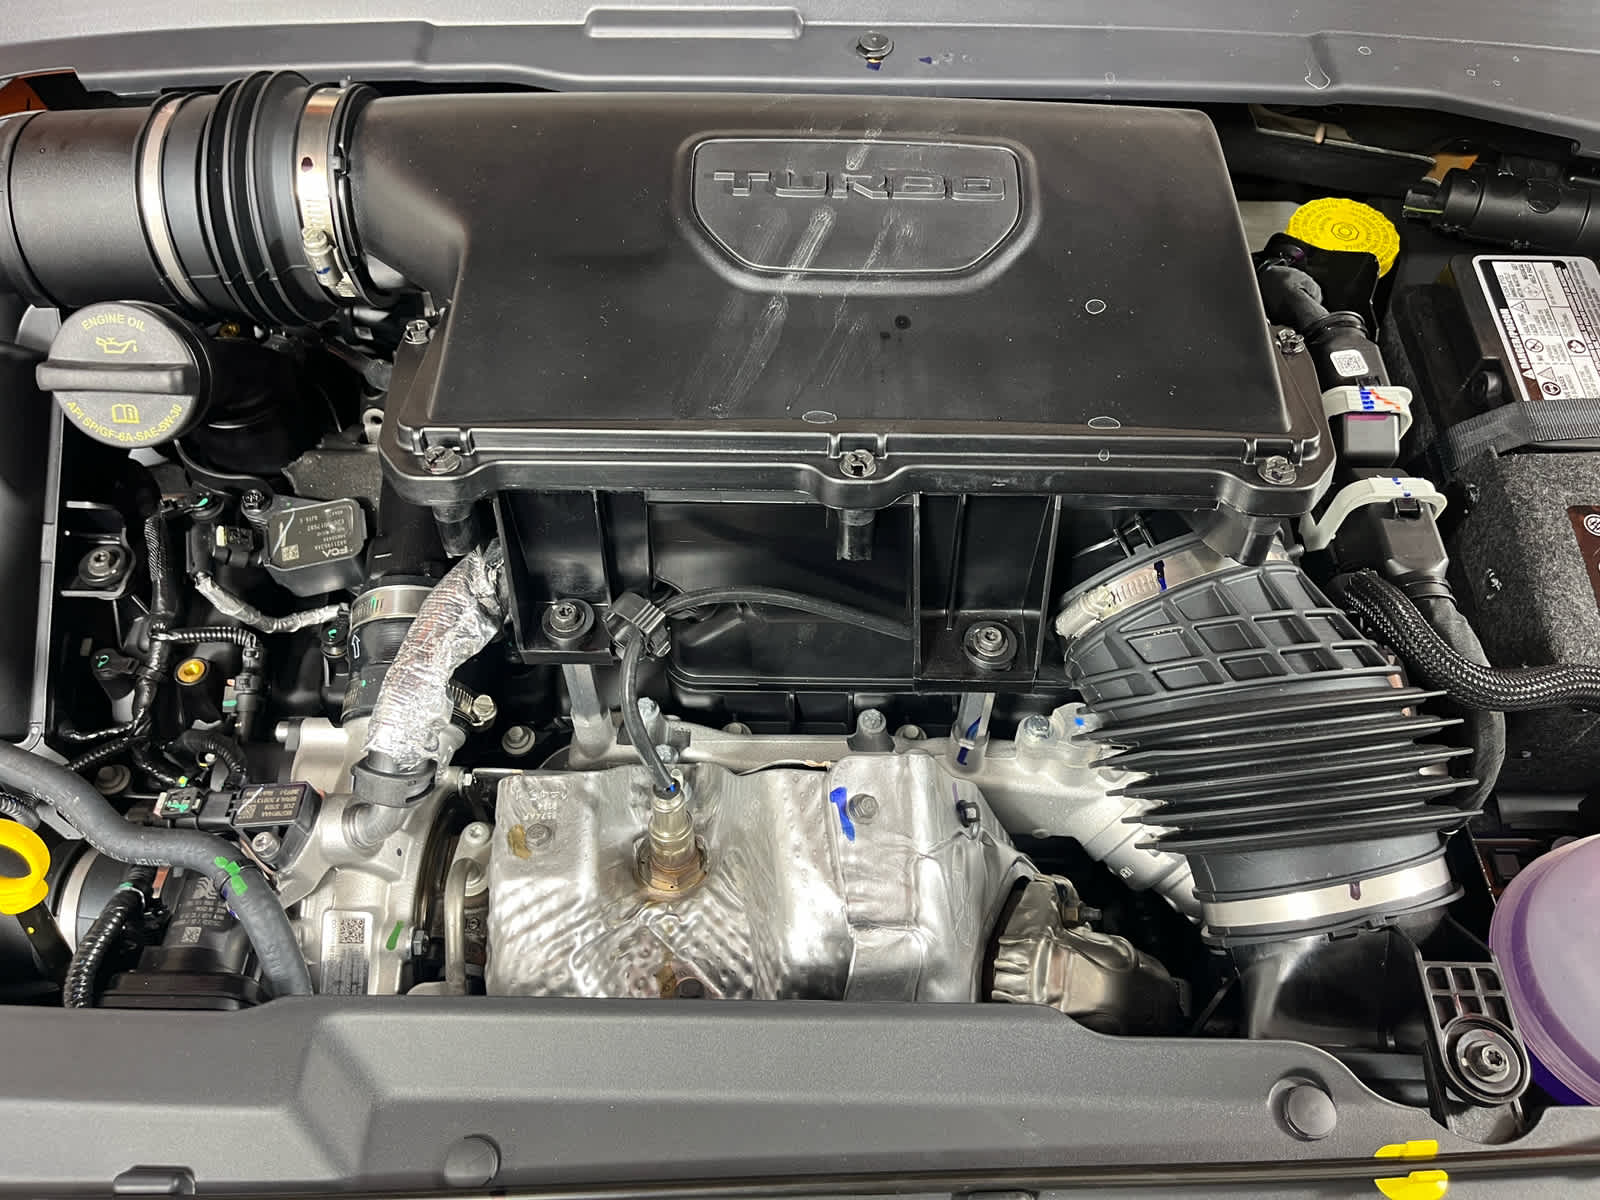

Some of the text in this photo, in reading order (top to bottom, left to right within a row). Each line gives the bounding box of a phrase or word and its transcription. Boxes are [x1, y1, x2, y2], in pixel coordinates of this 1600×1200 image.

[713, 169, 1006, 201] TURBO
[81, 312, 146, 333] ENGINE OIL
[66, 401, 85, 420] API
[322, 546, 348, 558] FCA
